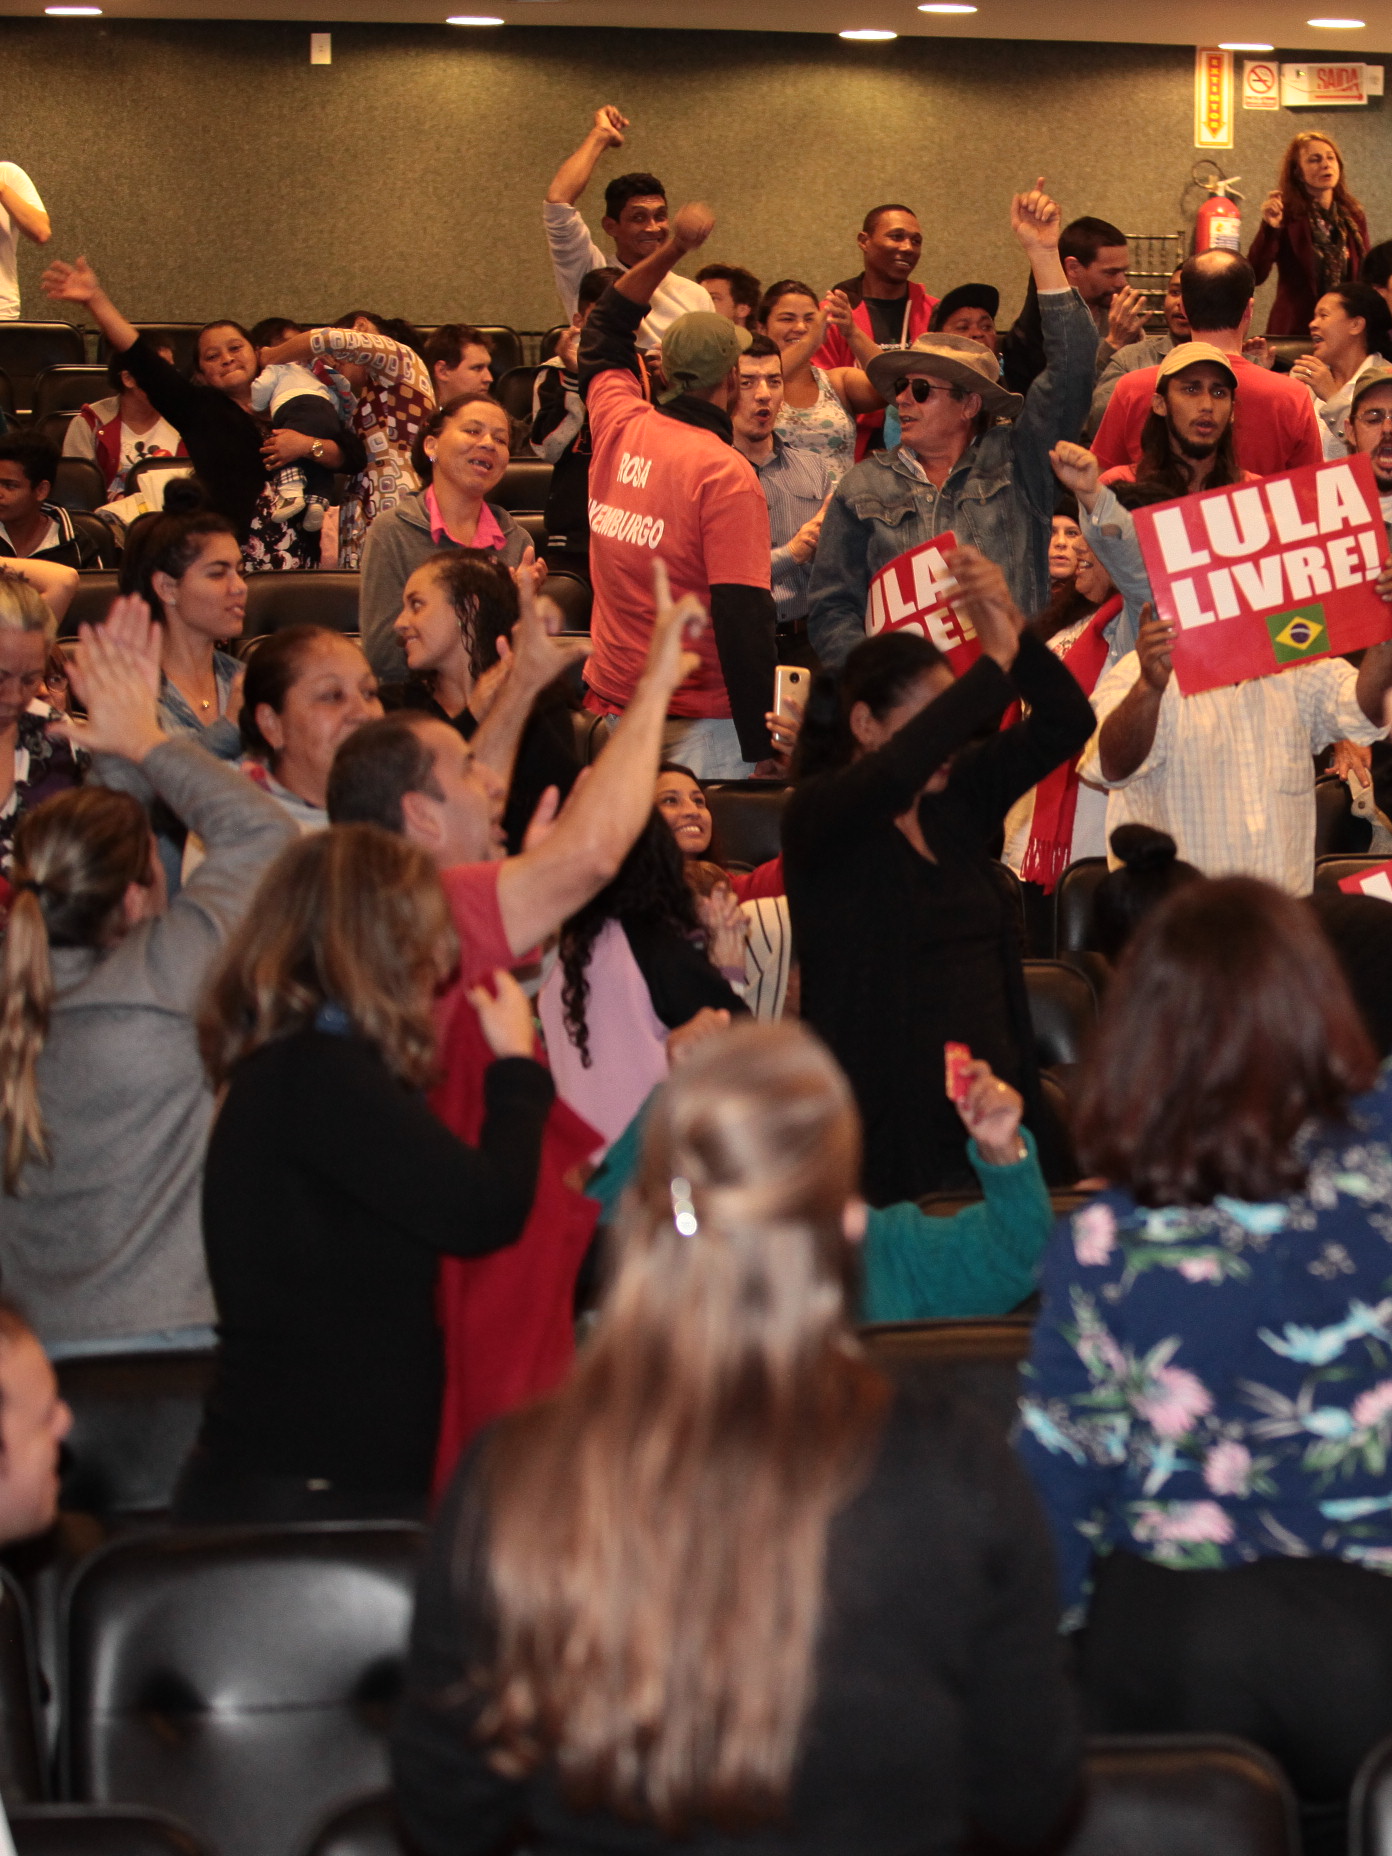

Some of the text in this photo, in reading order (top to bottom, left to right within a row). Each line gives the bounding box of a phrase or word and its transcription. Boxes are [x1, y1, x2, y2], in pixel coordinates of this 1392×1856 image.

[1208, 57, 1221, 128] EXTINTOR
[616, 451, 652, 489] ROSA
[588, 498, 665, 549] XEMBURGO
[1152, 464, 1373, 575] LULA
[1170, 530, 1382, 630] LIVRE!
